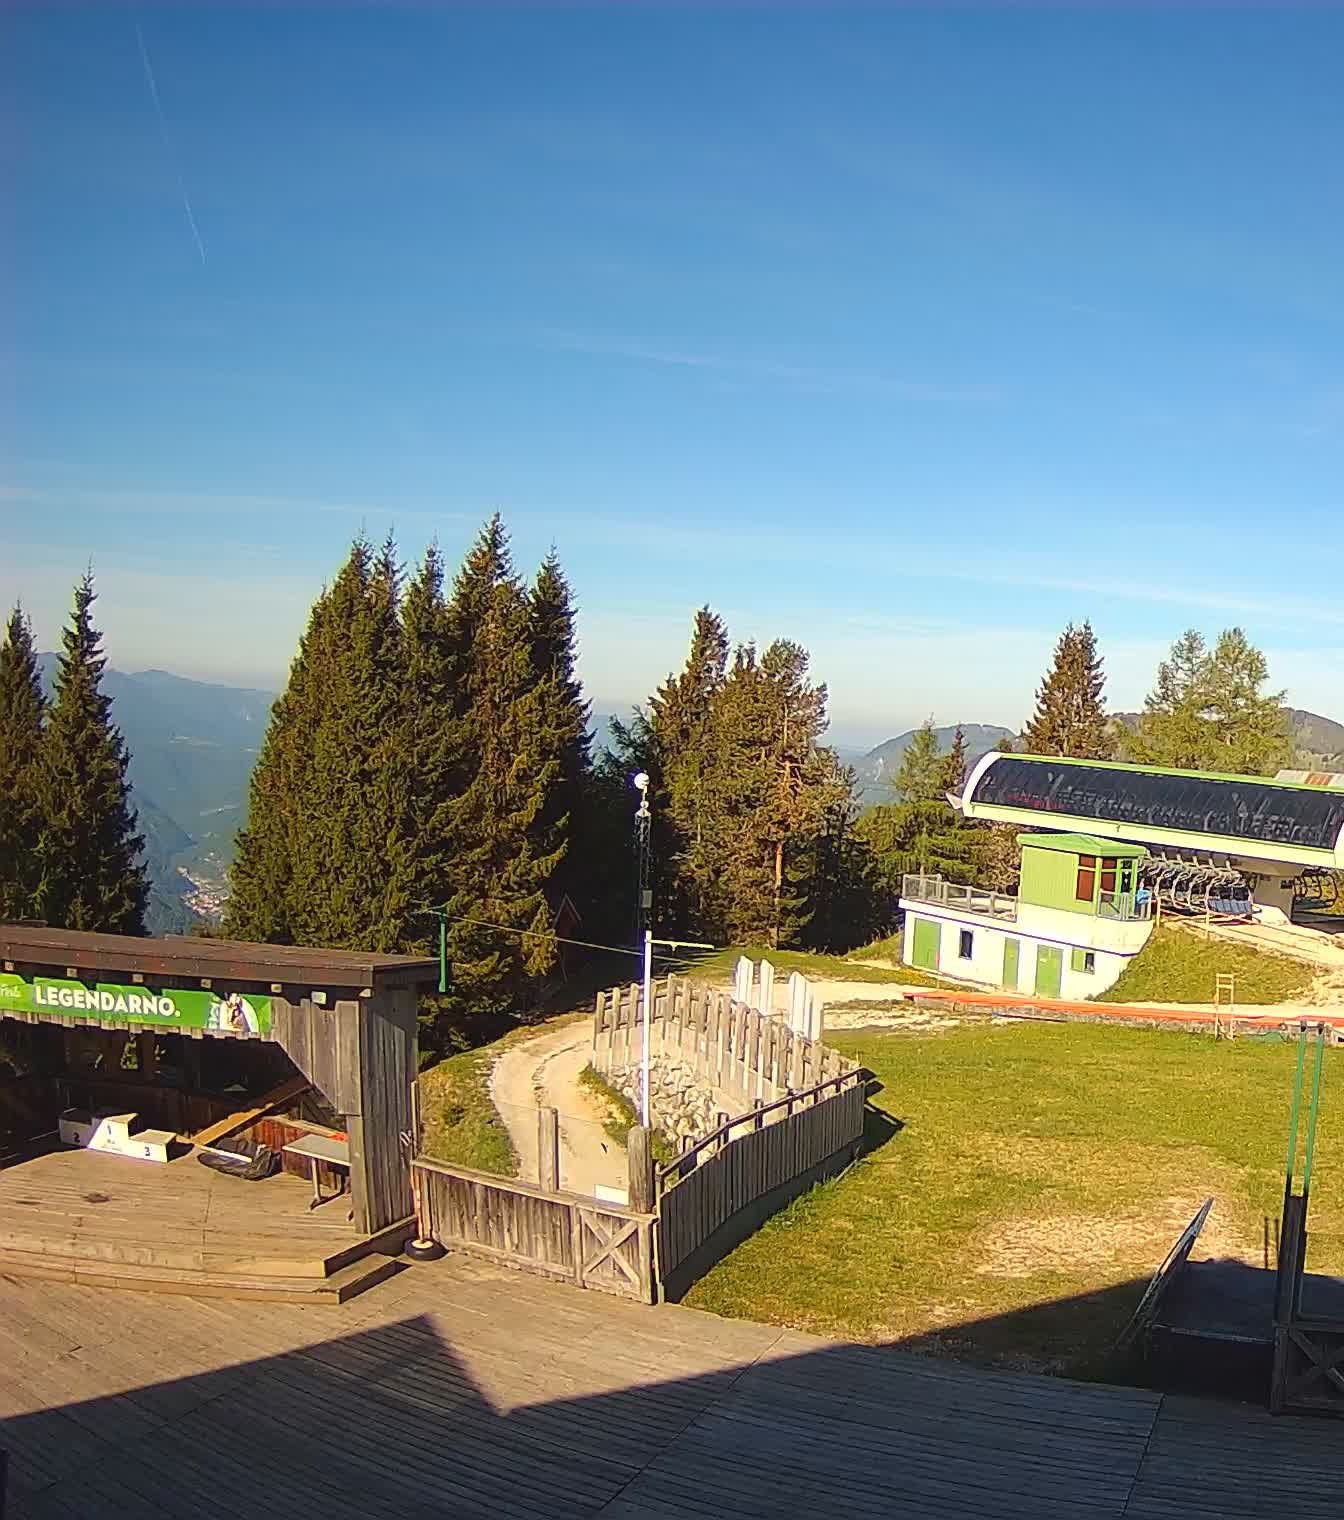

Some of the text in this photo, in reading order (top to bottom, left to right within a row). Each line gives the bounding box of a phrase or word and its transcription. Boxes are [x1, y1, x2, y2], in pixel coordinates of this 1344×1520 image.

[35, 984, 181, 1018] LEGENDARNO.
[72, 1132, 81, 1143] 2
[143, 1146, 151, 1157] 3
